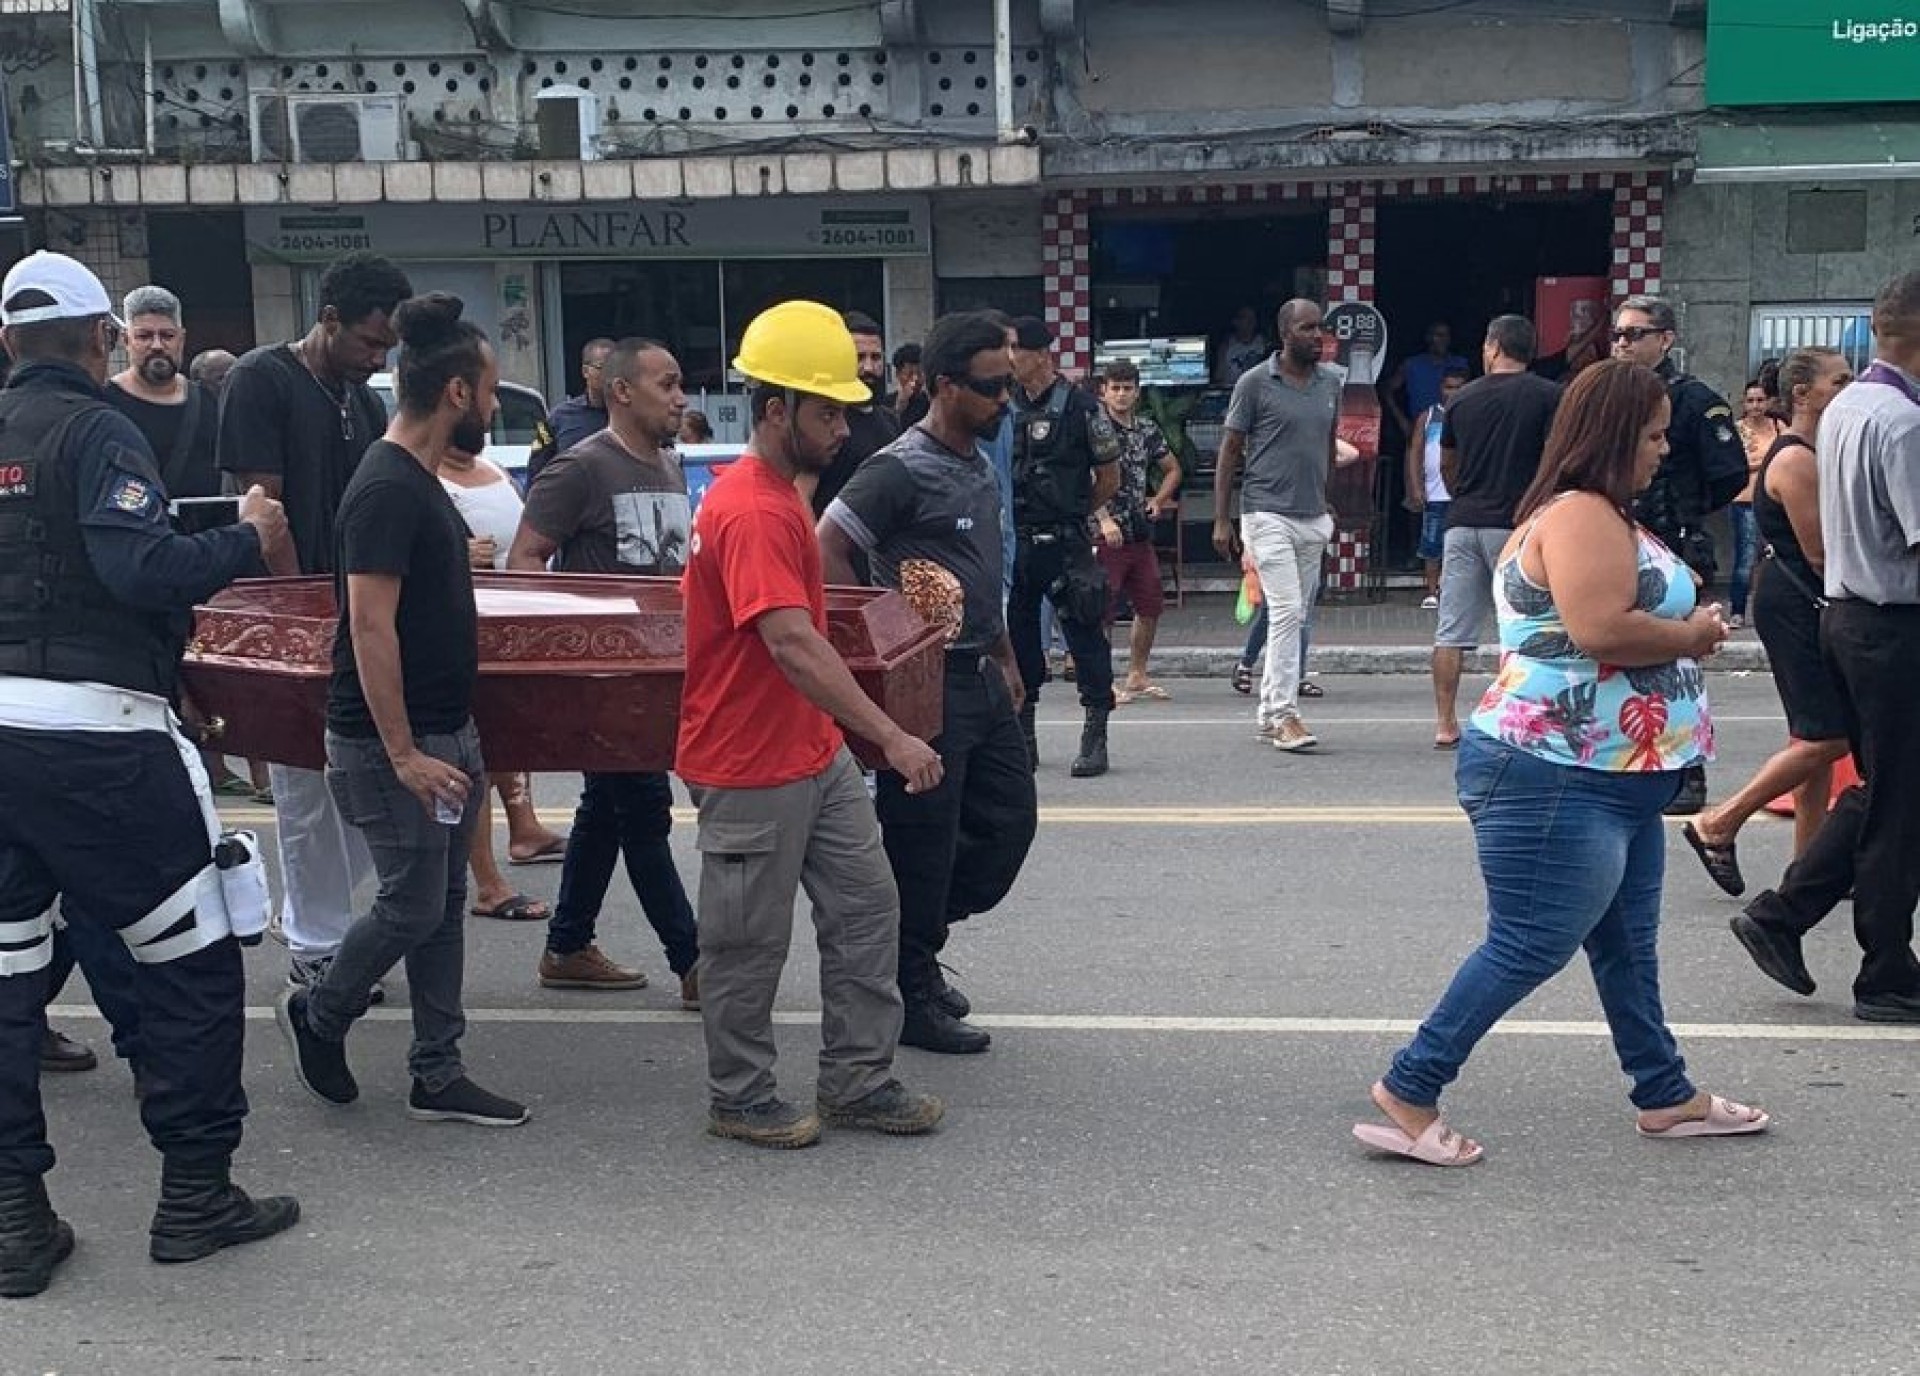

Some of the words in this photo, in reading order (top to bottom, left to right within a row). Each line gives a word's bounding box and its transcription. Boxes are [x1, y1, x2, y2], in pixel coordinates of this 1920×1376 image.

[1833, 18, 1917, 43] Ligação
[481, 211, 691, 249] PLANFAR
[821, 229, 915, 245] 2604-1081
[281, 234, 370, 250] 2604-1081
